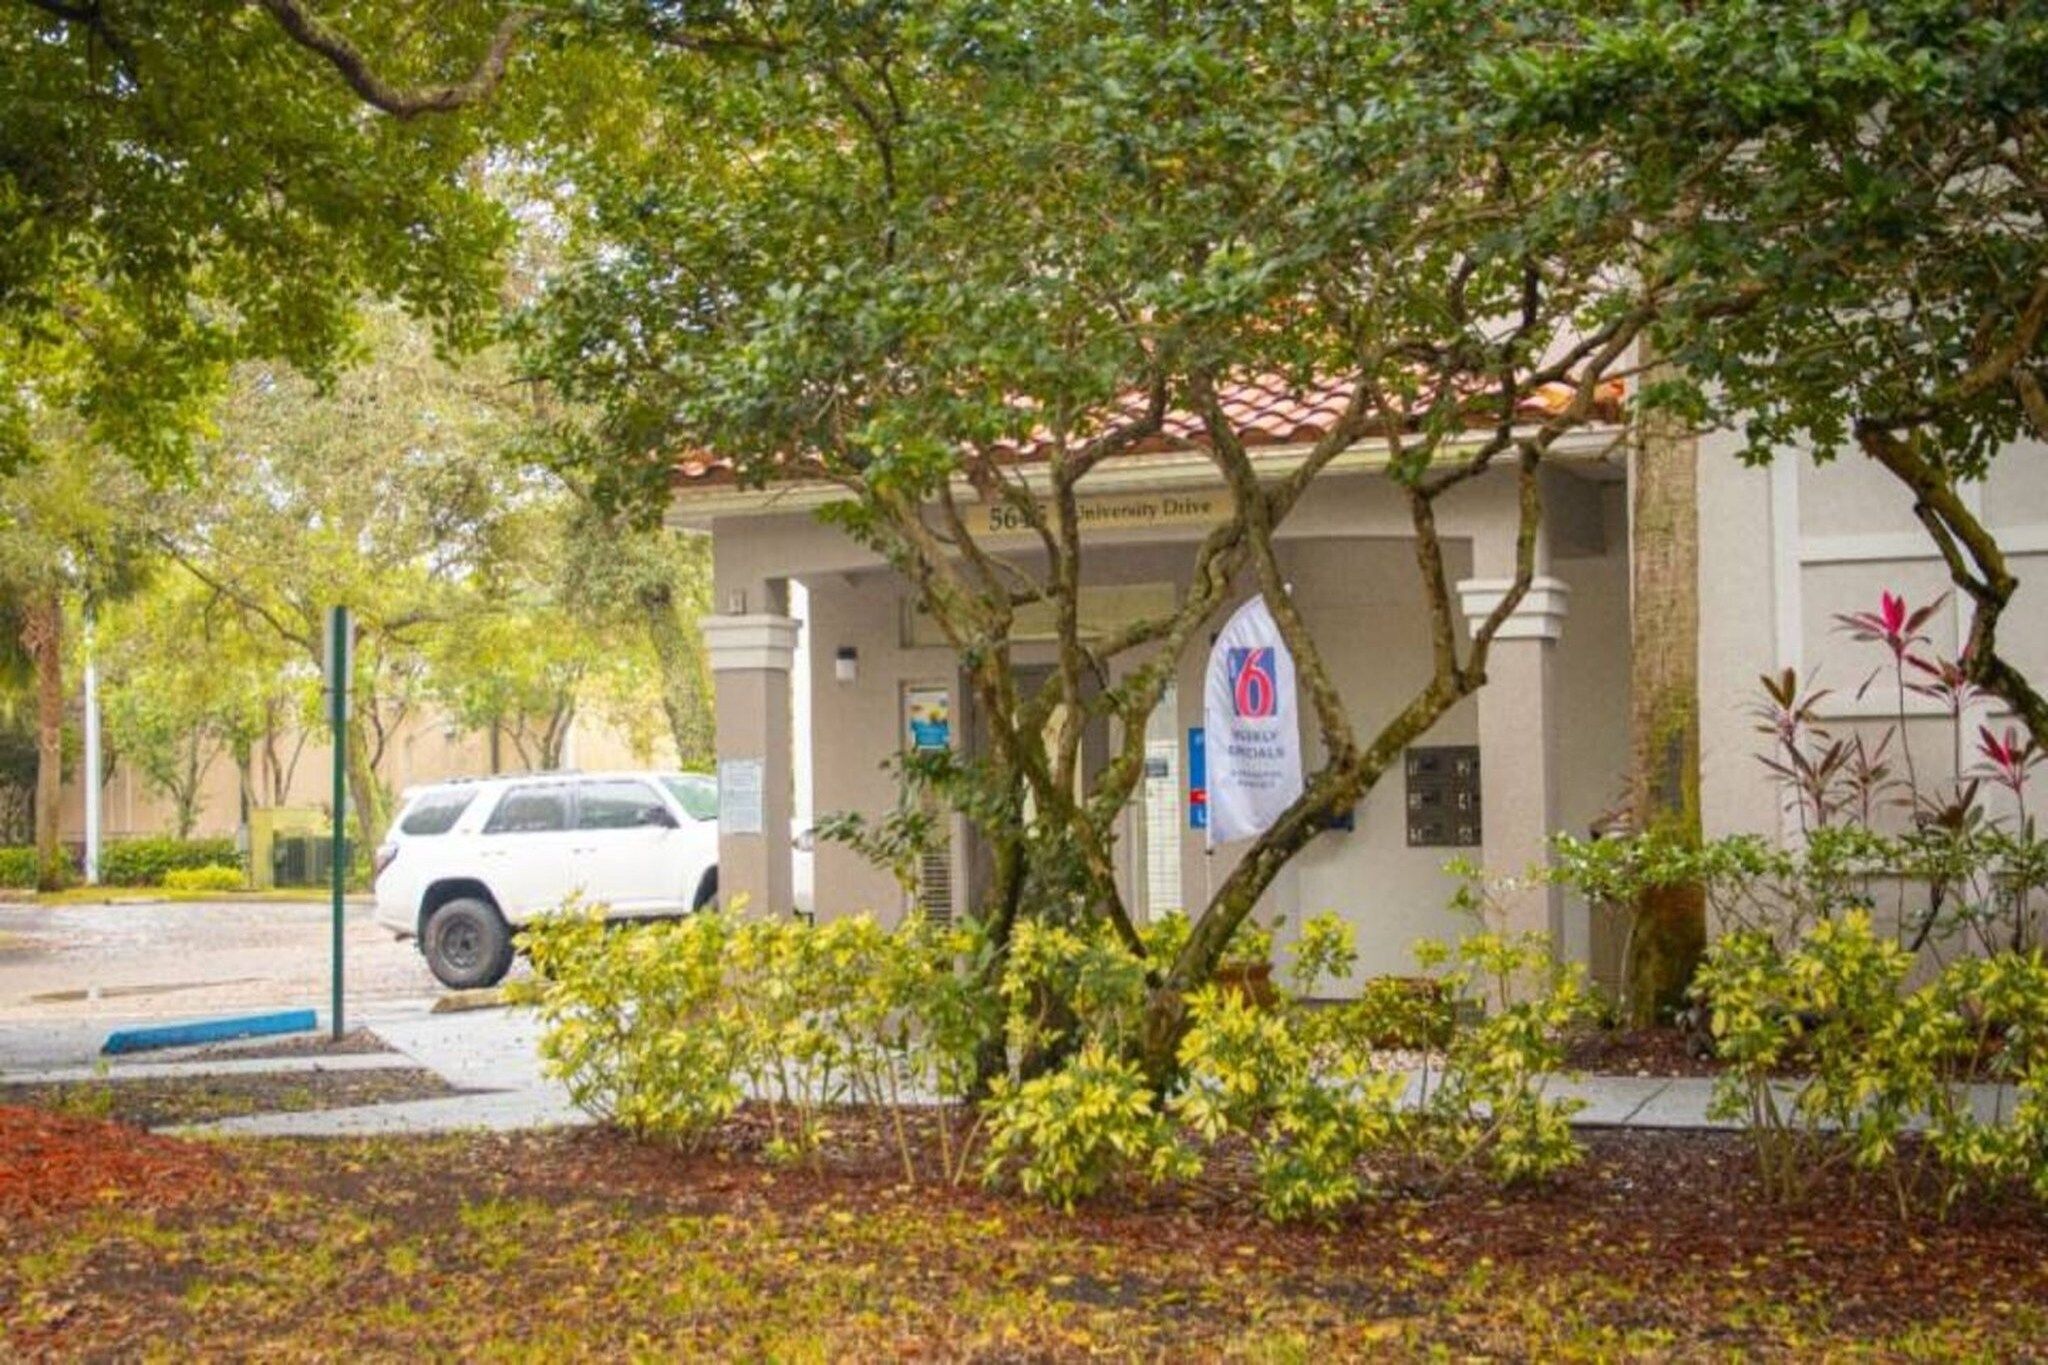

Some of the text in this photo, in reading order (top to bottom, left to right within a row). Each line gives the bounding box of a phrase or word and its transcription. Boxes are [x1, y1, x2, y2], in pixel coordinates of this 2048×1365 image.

[989, 505, 1046, 531] 565
[1163, 497, 1212, 515] Drive
[1235, 647, 1274, 720] 6
